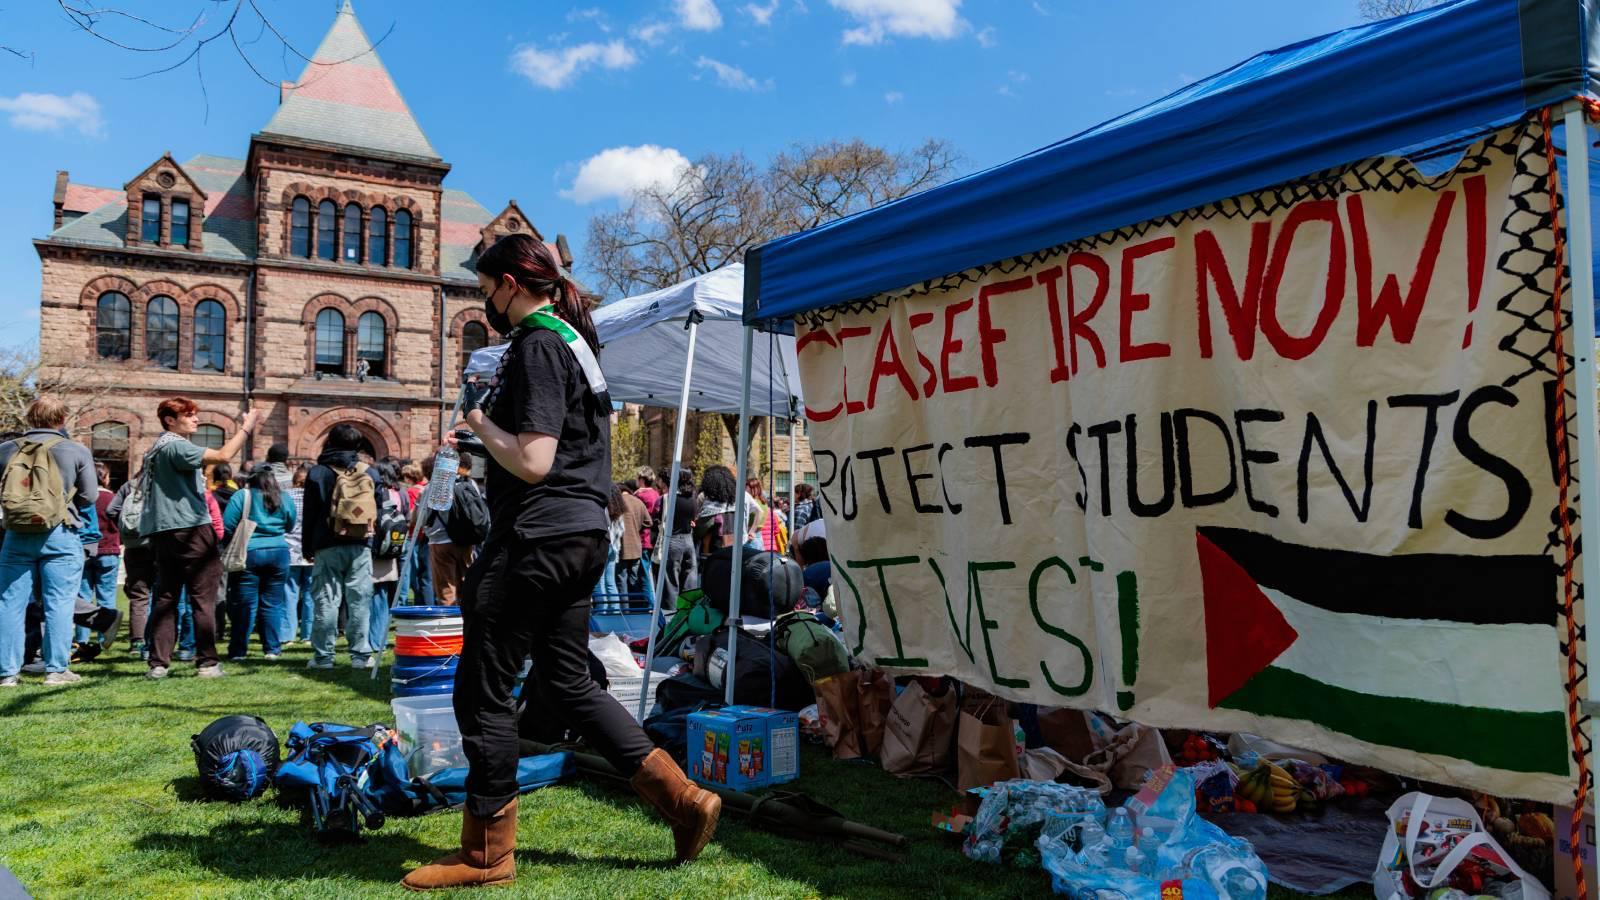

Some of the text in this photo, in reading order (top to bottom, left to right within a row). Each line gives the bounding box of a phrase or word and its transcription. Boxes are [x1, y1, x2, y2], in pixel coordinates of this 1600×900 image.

[797, 174, 1486, 421] CEASEFIRE NOW!
[812, 379, 1572, 540] ROTECT STUDENTS!
[830, 555, 1141, 712] DIVES!
